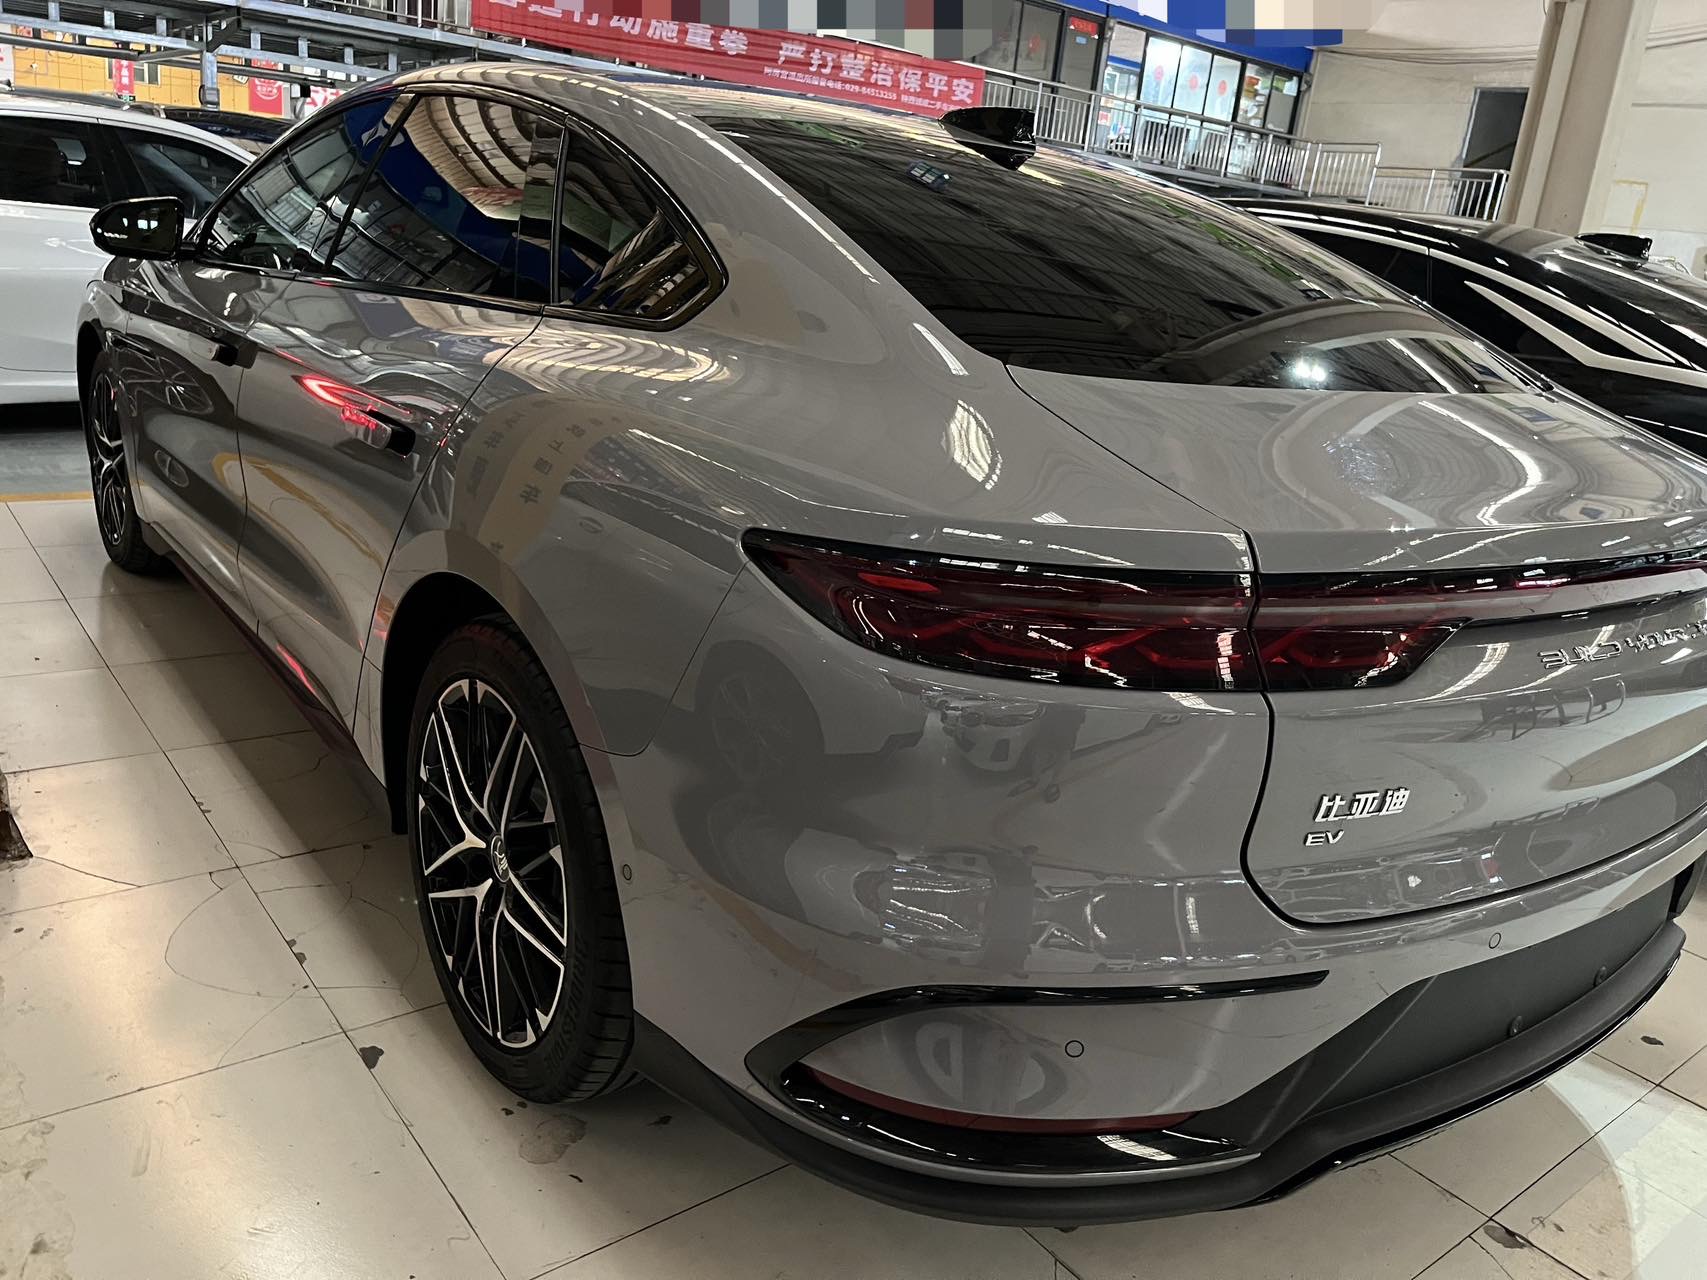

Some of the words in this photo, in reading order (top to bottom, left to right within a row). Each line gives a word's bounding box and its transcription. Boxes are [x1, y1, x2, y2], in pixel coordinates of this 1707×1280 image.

[778, 39, 974, 104] 严打整治保平安
[1313, 787, 1410, 822] 比亚迪
[1303, 829, 1344, 846] EV
